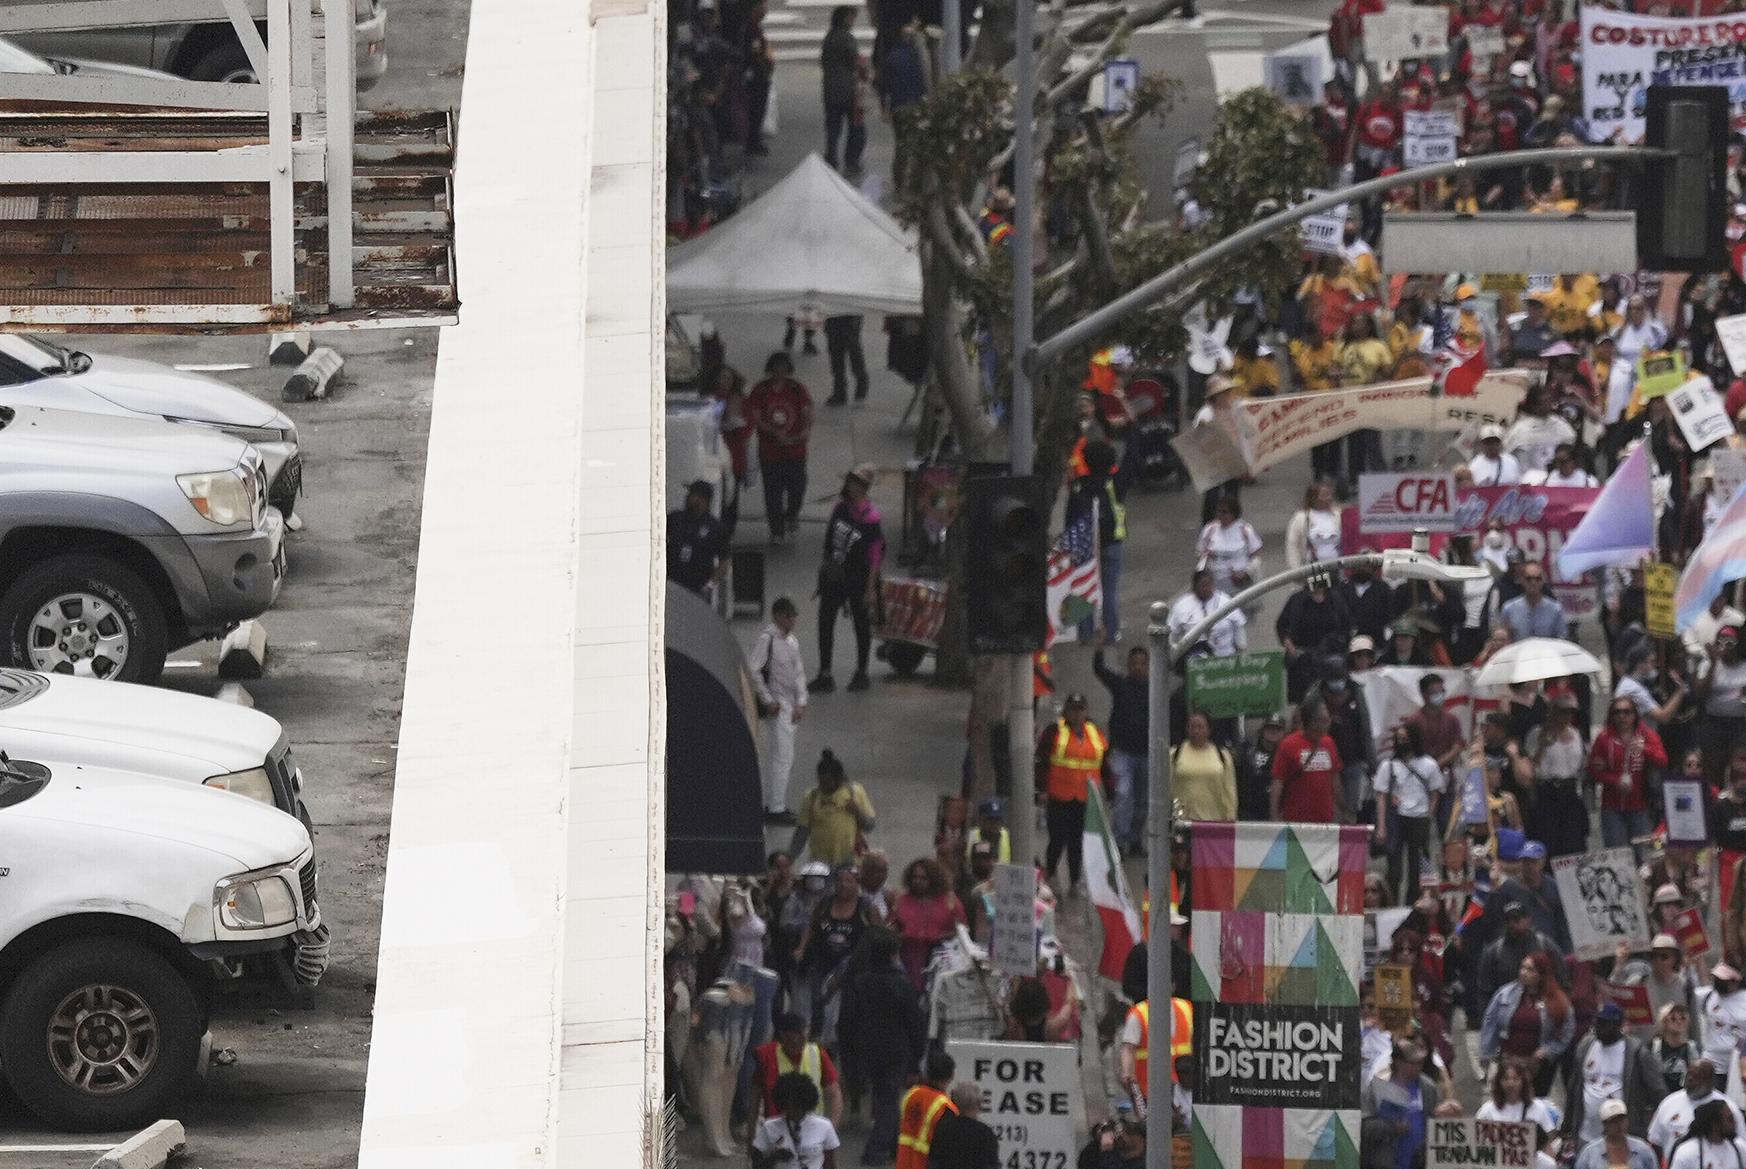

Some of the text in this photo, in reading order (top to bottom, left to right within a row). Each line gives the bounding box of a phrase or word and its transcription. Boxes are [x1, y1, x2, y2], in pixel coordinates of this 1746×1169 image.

[1396, 478, 1450, 516] CFA
[1209, 1018, 1343, 1051] FASHION
[974, 1059, 1045, 1083] FOR
[1209, 1049, 1343, 1083] DISTRICT
[1434, 1121, 1465, 1146] MIS
